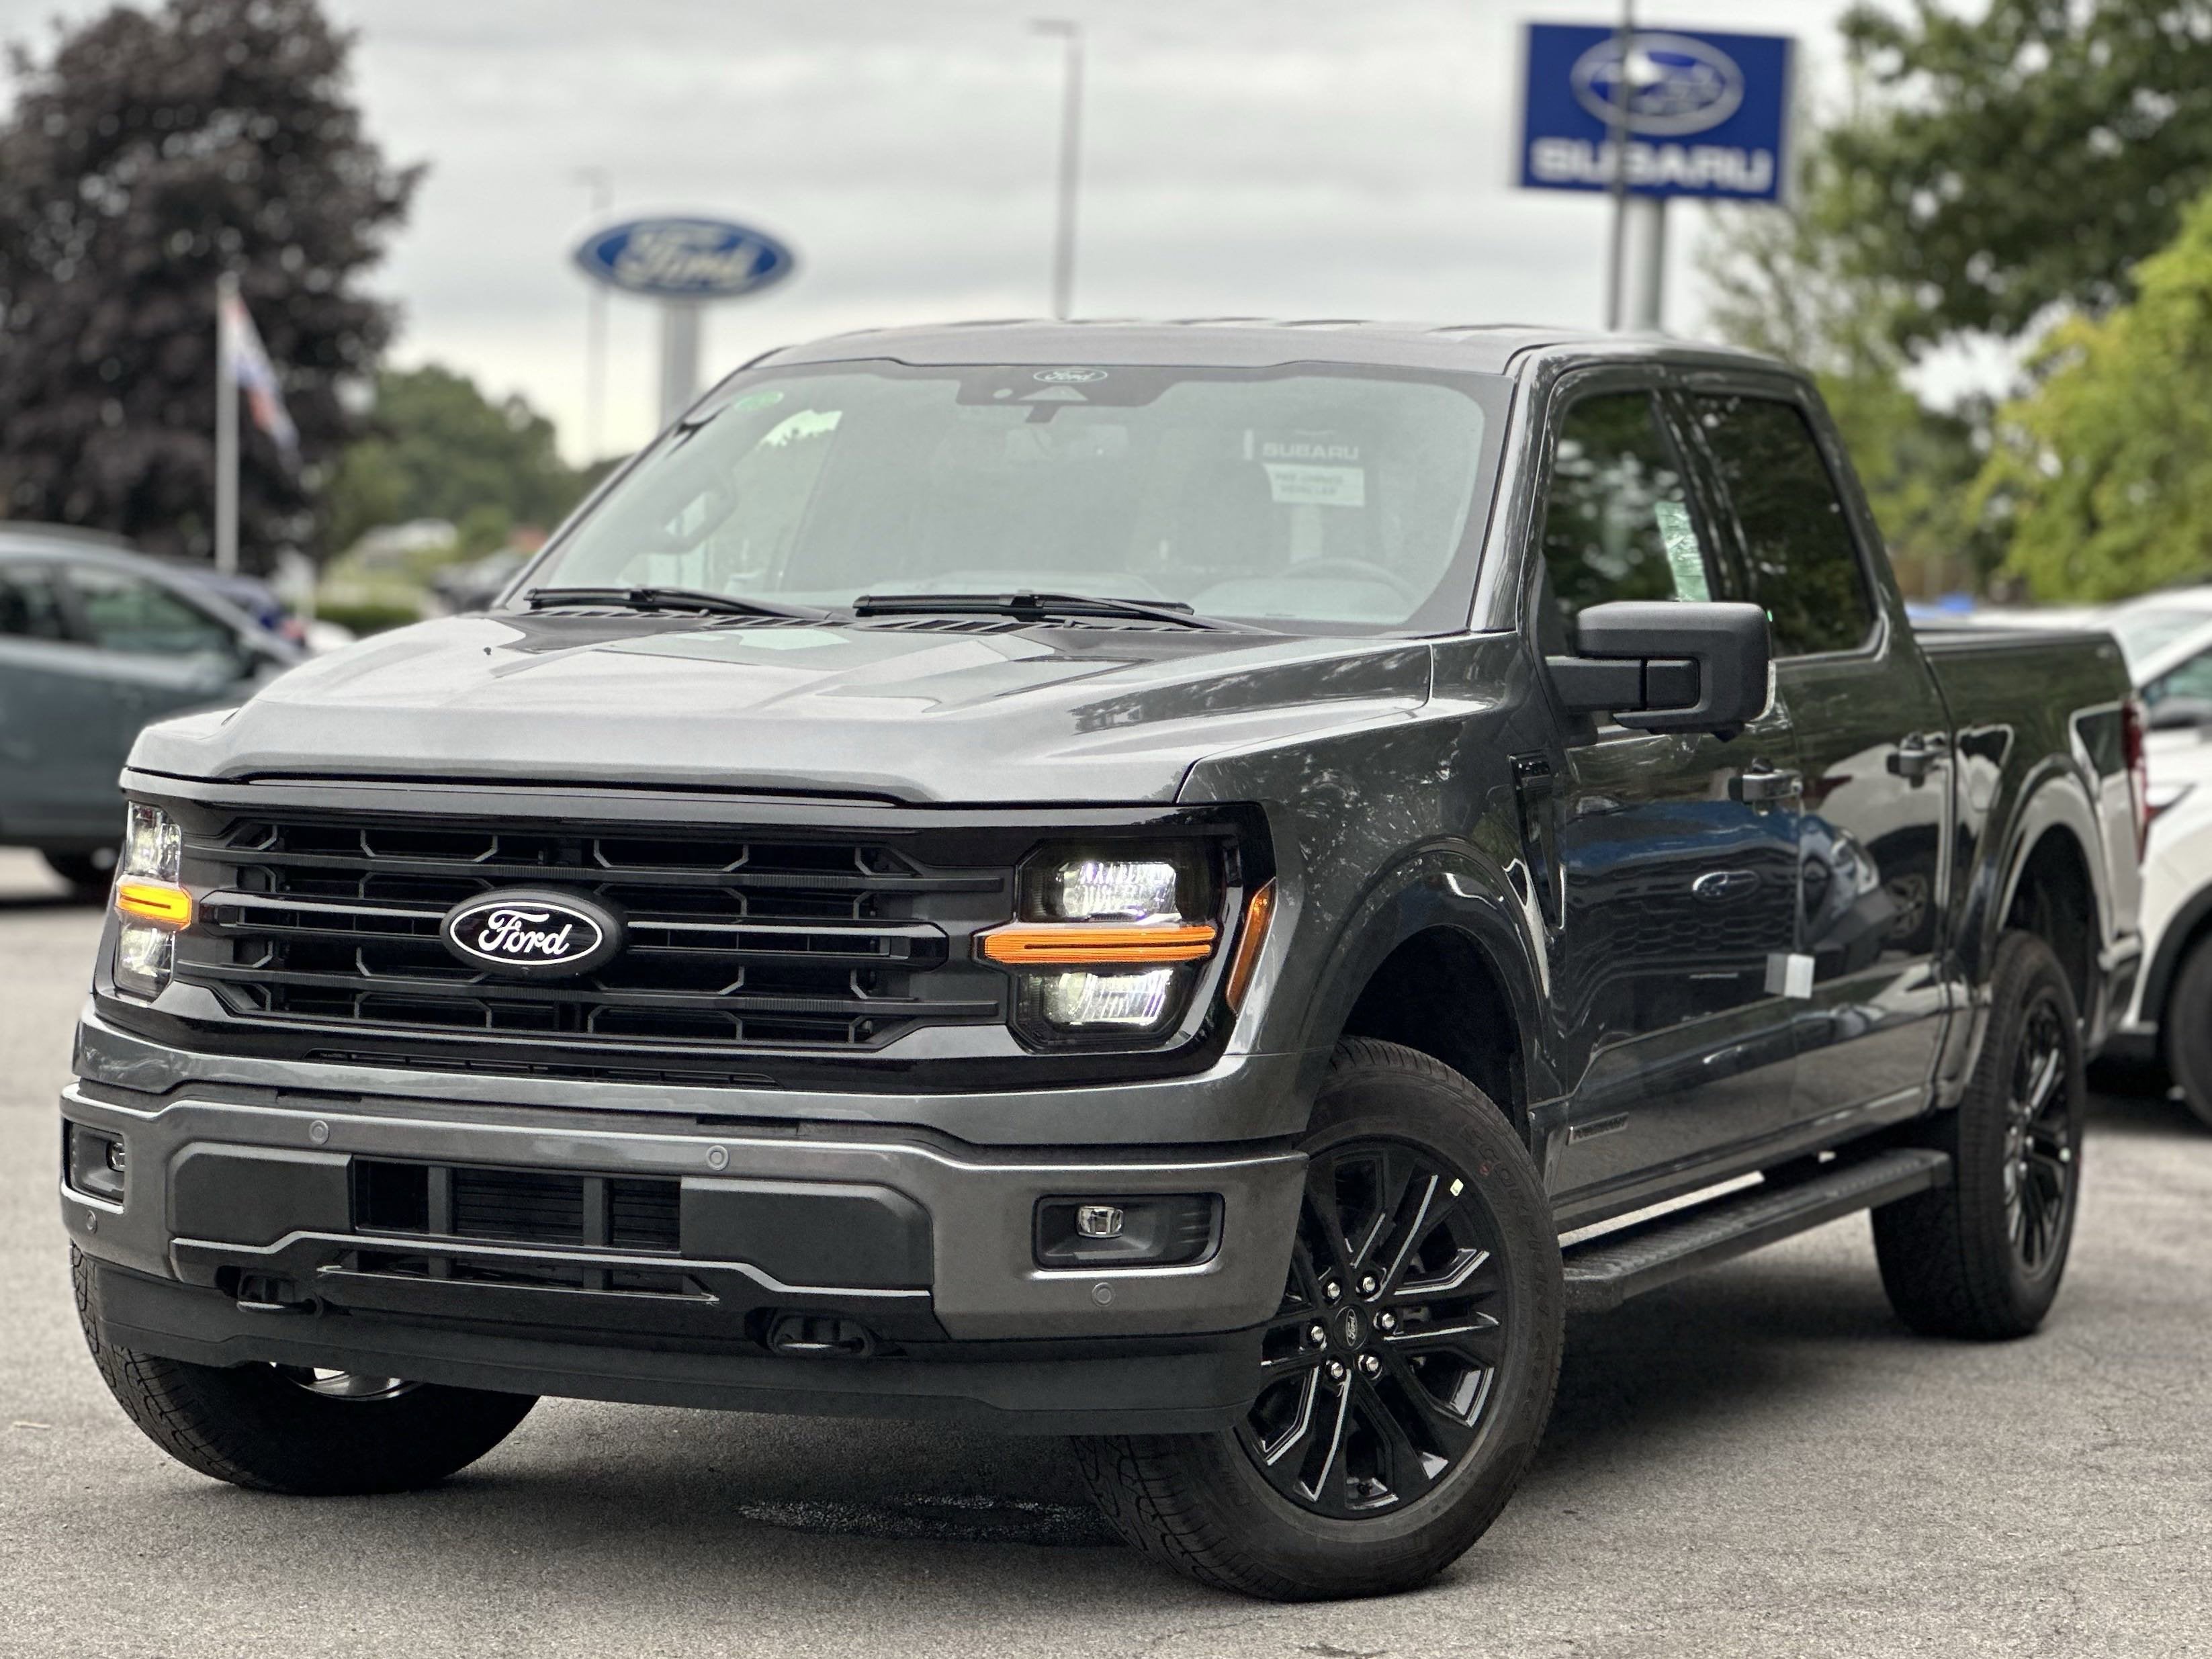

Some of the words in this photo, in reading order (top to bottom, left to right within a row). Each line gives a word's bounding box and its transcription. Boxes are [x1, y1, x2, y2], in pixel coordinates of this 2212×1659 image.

[1529, 137, 1775, 193] SUBARU
[1045, 370, 1096, 382] Ford
[1263, 442, 1359, 460] SUBARU
[478, 909, 573, 956] Ford
